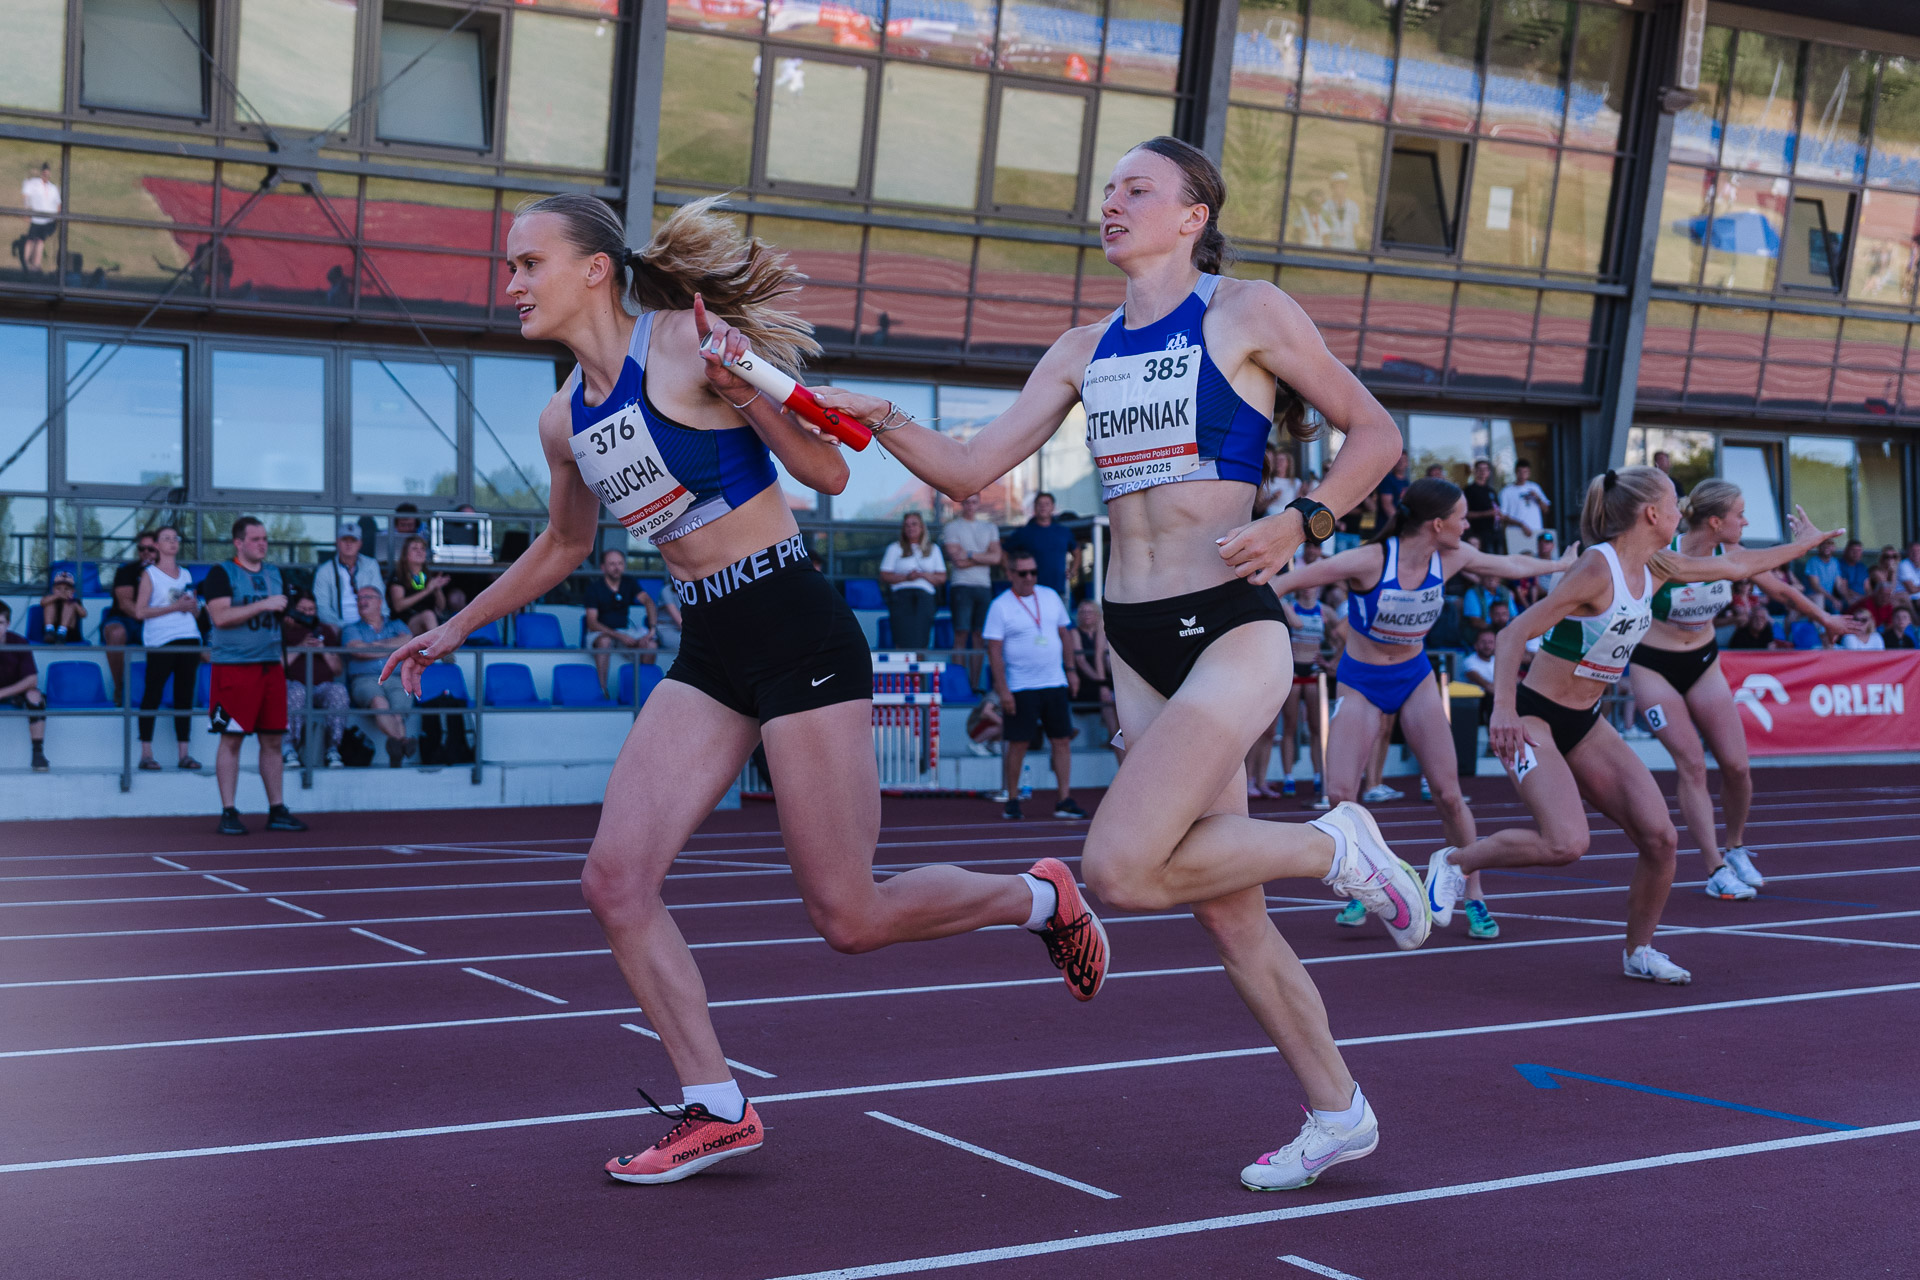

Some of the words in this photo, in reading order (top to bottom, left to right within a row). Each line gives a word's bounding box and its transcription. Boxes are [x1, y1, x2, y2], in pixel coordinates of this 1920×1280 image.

[1143, 354, 1189, 382] 385
[590, 415, 635, 455] 376
[1113, 452, 1151, 464] Mistrzostwa
[1152, 448, 1171, 458] Polski
[1171, 446, 1185, 455] U23
[1102, 465, 1145, 481] KRAKÓW
[1146, 462, 1172, 475] 2025
[644, 501, 663, 515] Polski
[662, 493, 676, 506] U23
[647, 509, 674, 530] 2025
[702, 548, 774, 603] NIKE
[775, 532, 808, 569] PR
[1710, 583, 1724, 595] 48
[1179, 626, 1205, 637] erima
[1809, 683, 1905, 717] ORLEN
[1648, 709, 1661, 728] 8
[672, 1147, 700, 1163] new
[702, 1124, 756, 1152] balance
